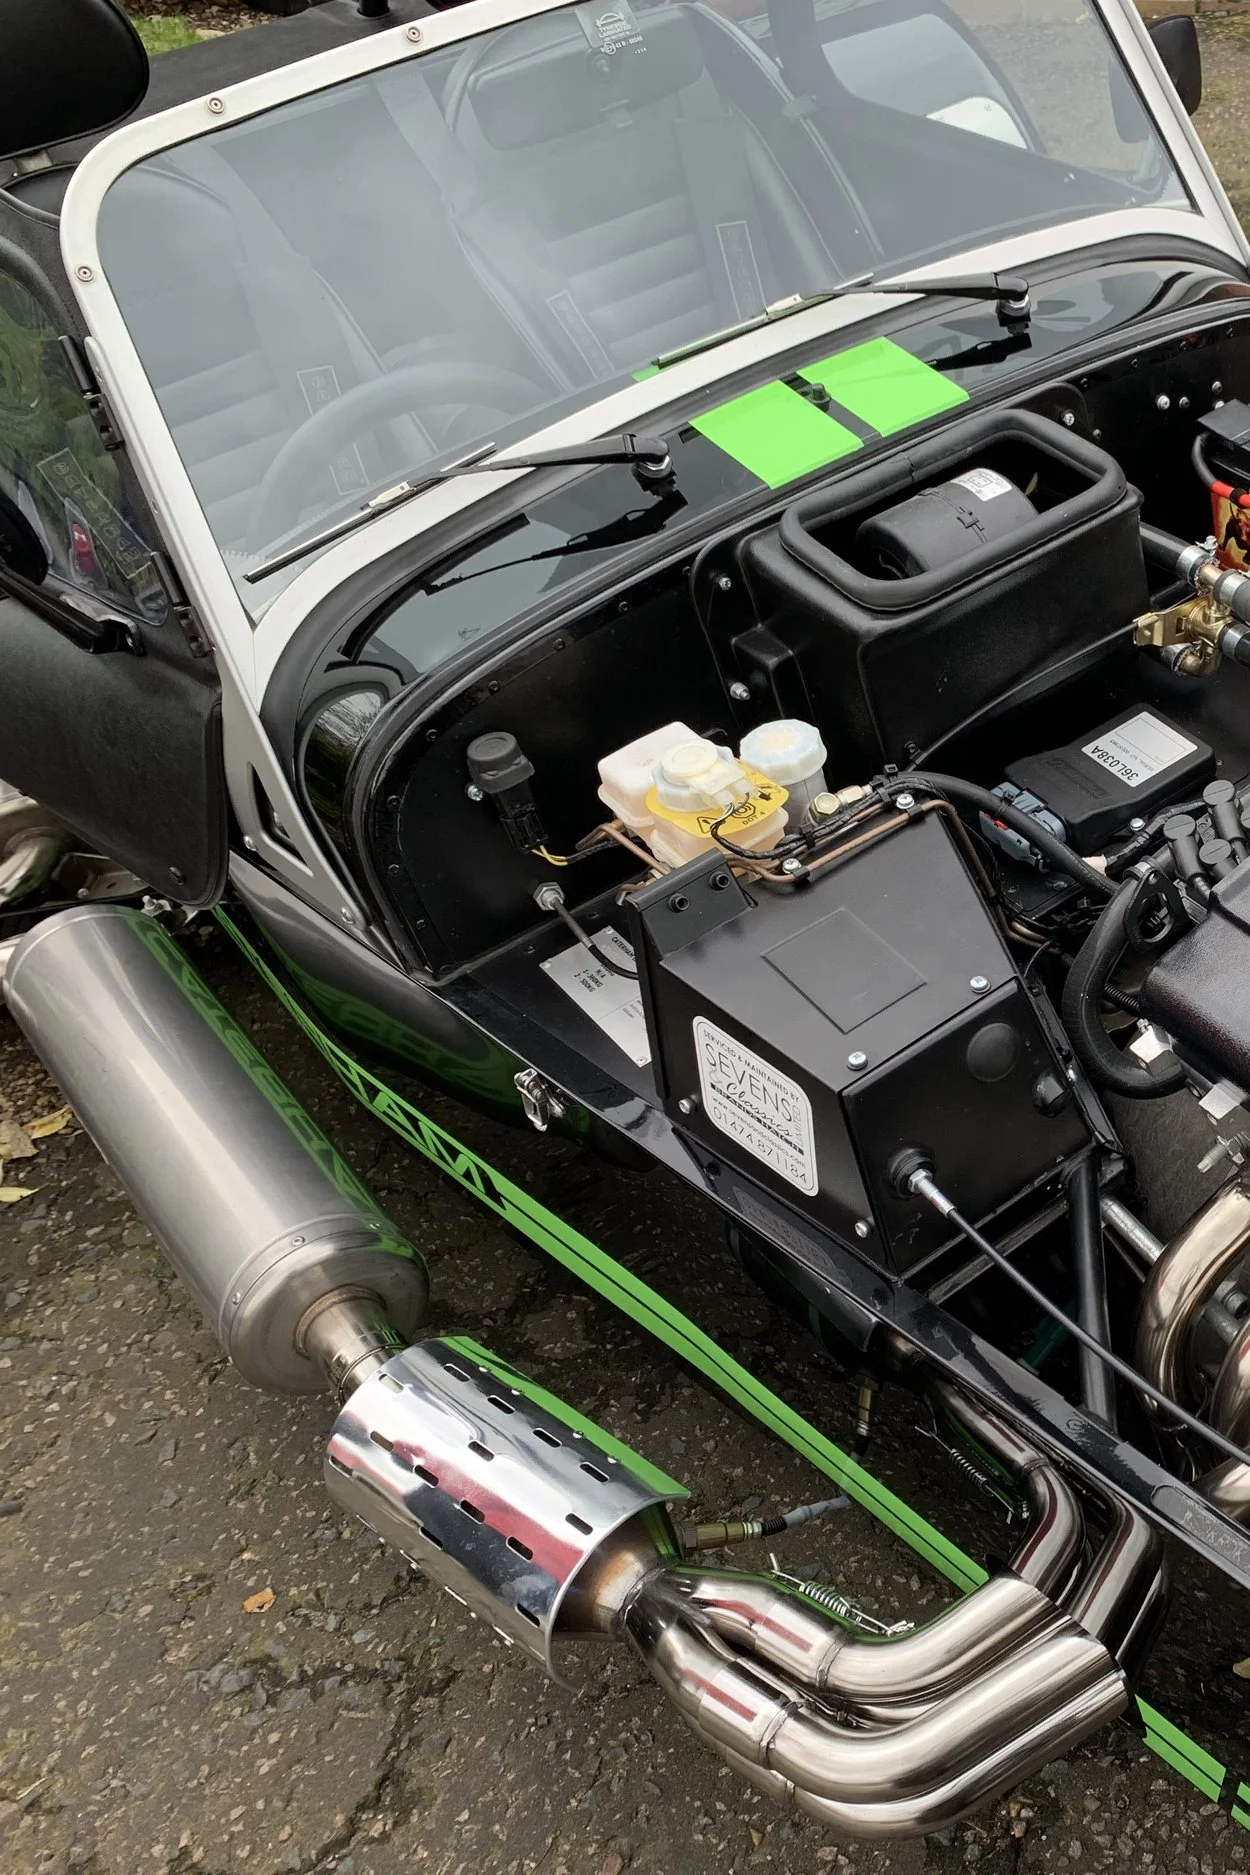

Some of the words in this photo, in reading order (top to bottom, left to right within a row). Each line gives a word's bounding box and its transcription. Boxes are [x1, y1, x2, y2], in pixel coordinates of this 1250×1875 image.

[1091, 746, 1139, 780] 36L038A
[742, 814, 756, 826] DOT
[703, 1030, 736, 1058] SERVICED
[744, 1059, 788, 1095] MAINTAINED
[790, 1092, 799, 1102] BY
[706, 1043, 792, 1122] SEVENS
[726, 1082, 792, 1137] Classics
[713, 1106, 753, 1144] 01474
[758, 1139, 807, 1183] 871184
